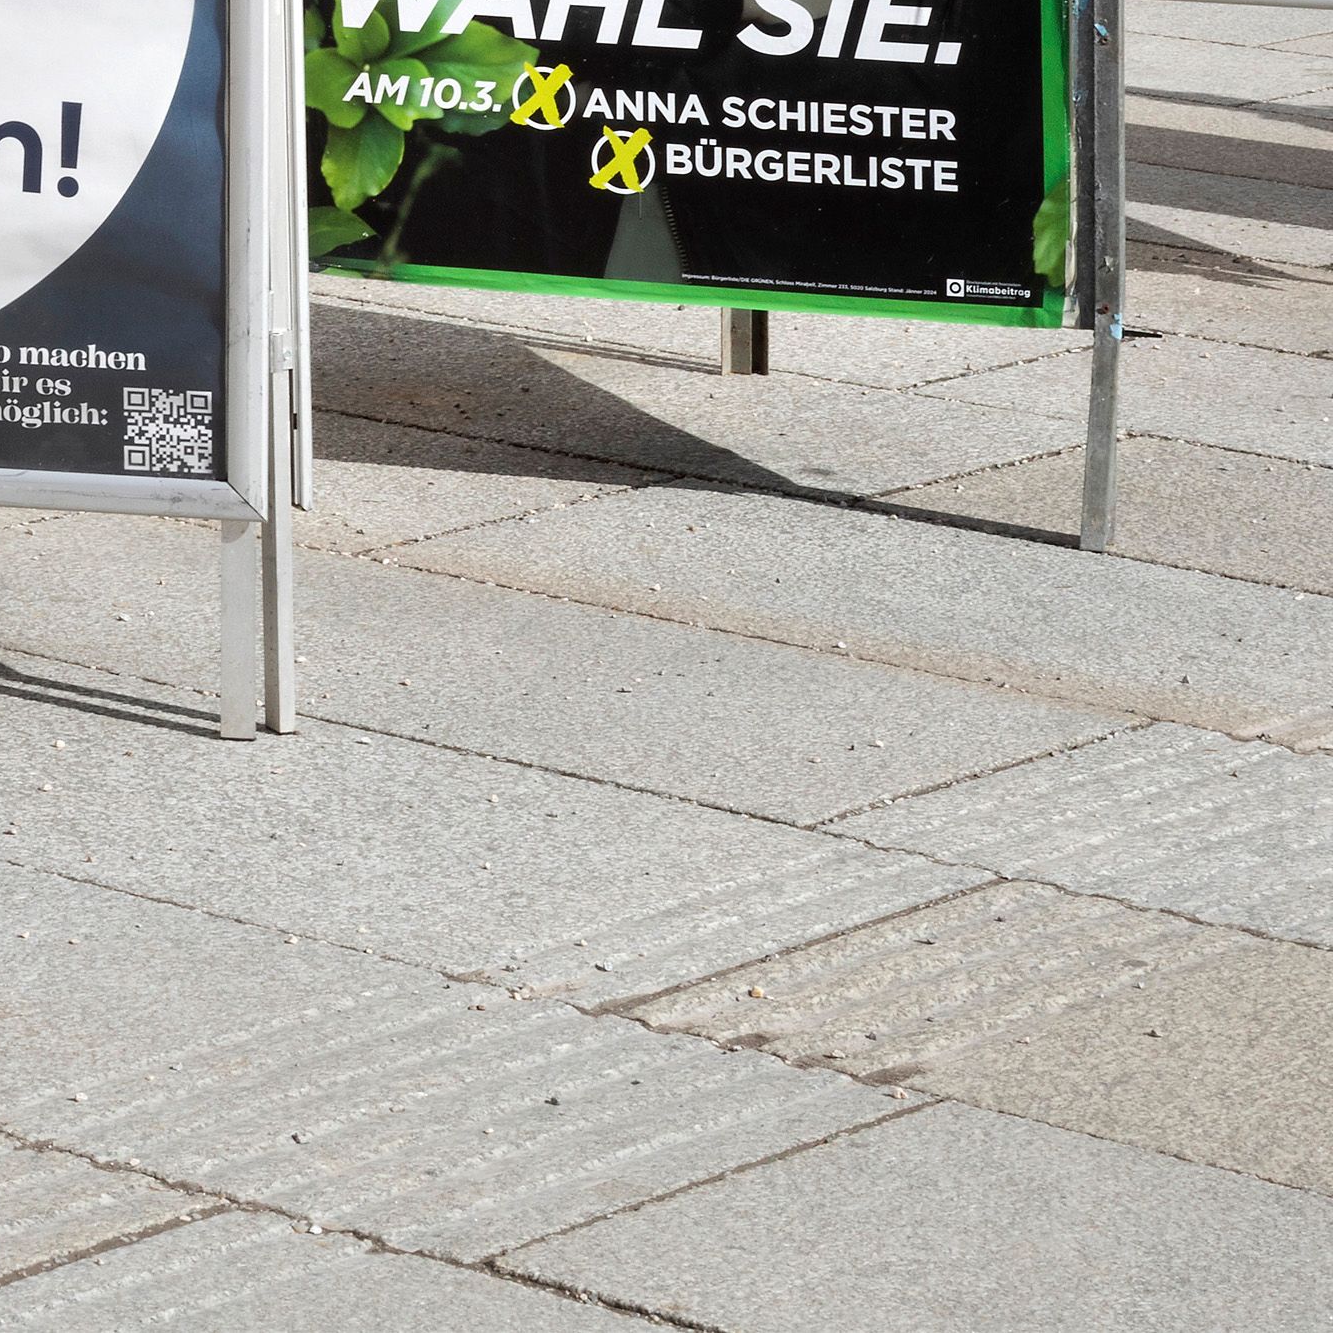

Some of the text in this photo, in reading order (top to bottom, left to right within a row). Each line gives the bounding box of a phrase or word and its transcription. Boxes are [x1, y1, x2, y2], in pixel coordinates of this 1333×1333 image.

[343, 73, 955, 140] AM 10.3. ANNA SCHIESTER
[667, 139, 958, 191] BÜRGERLISTE
[966, 285, 1030, 298] Klimabeitrag
[20, 345, 146, 370] machen
[36, 378, 71, 395] es
